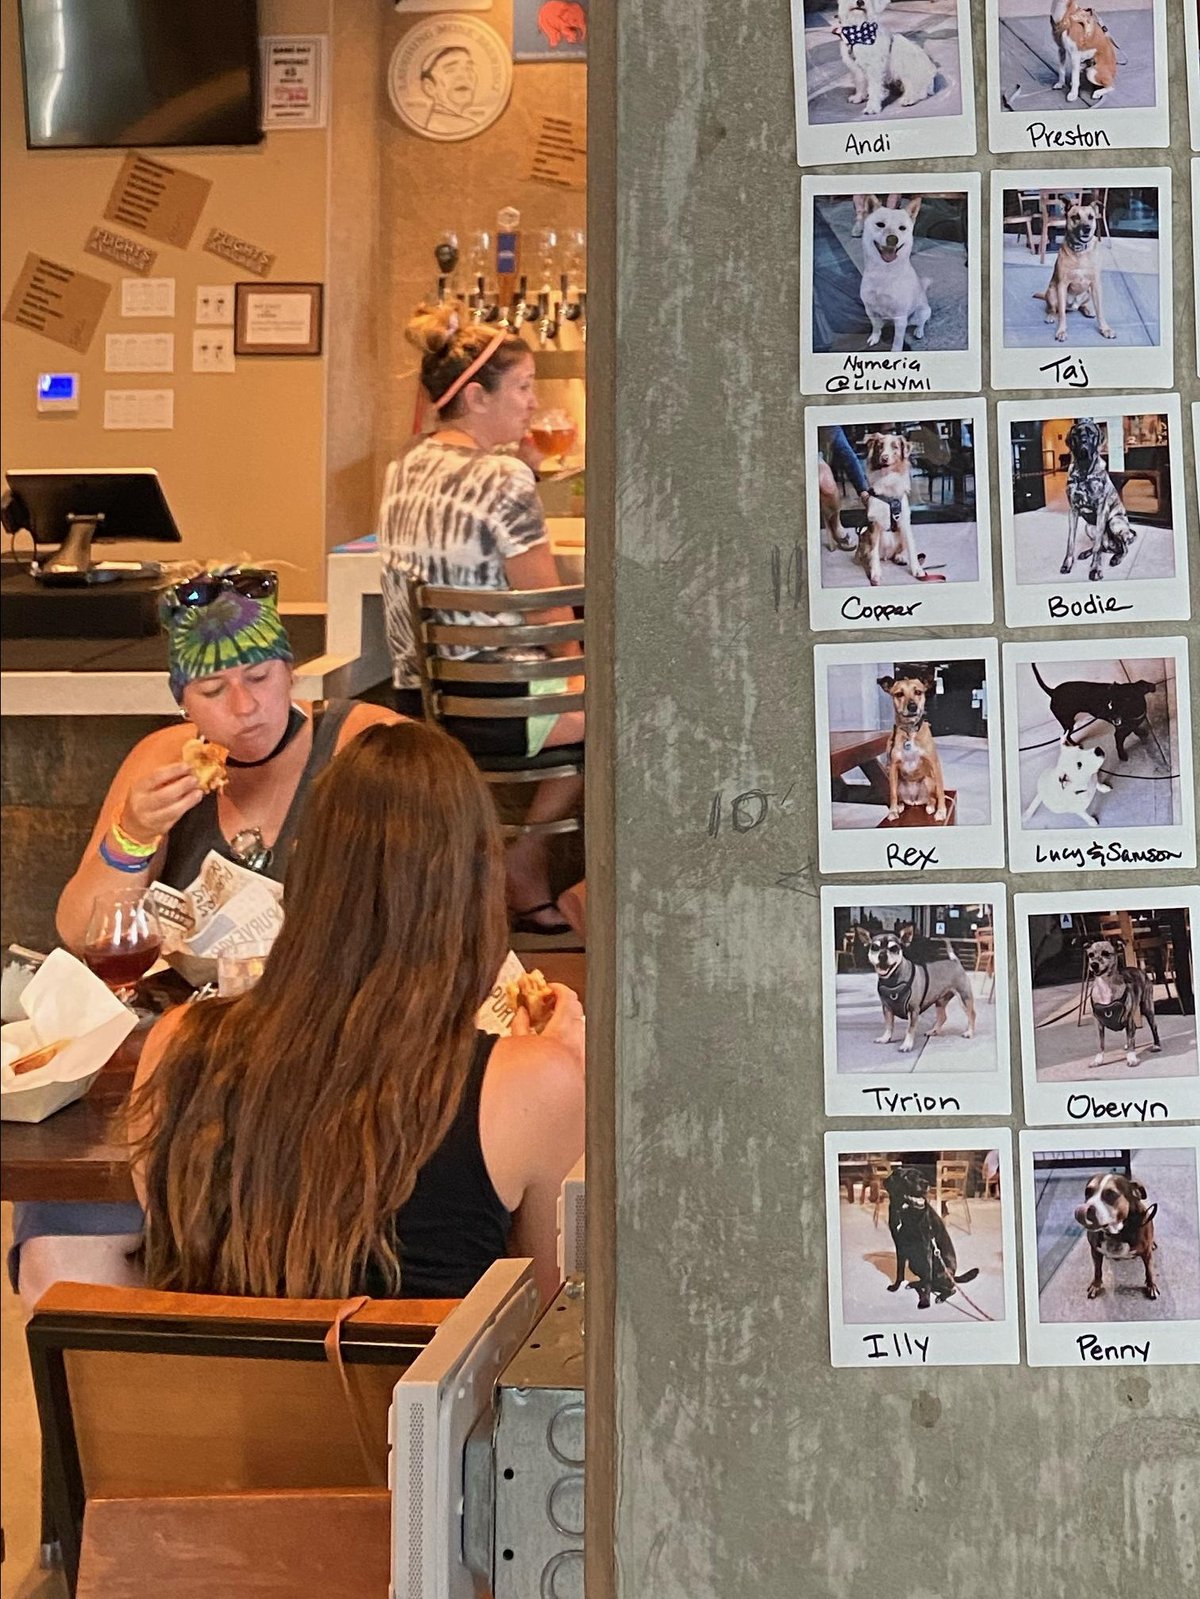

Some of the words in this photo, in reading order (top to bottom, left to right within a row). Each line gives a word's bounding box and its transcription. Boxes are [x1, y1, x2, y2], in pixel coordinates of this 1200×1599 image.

[844, 132, 891, 156] Andi
[1025, 122, 1111, 148] Preston
[842, 354, 921, 375] Nymeria
[1038, 354, 1089, 388] Taj
[840, 595, 923, 622] Copper
[1047, 593, 1134, 619] Bodie
[886, 842, 942, 871] Rex
[861, 1087, 961, 1113] Tyrion
[1066, 1094, 1172, 1123] Oberyn
[862, 1332, 930, 1363] Illy
[1075, 1333, 1151, 1363] Penny
